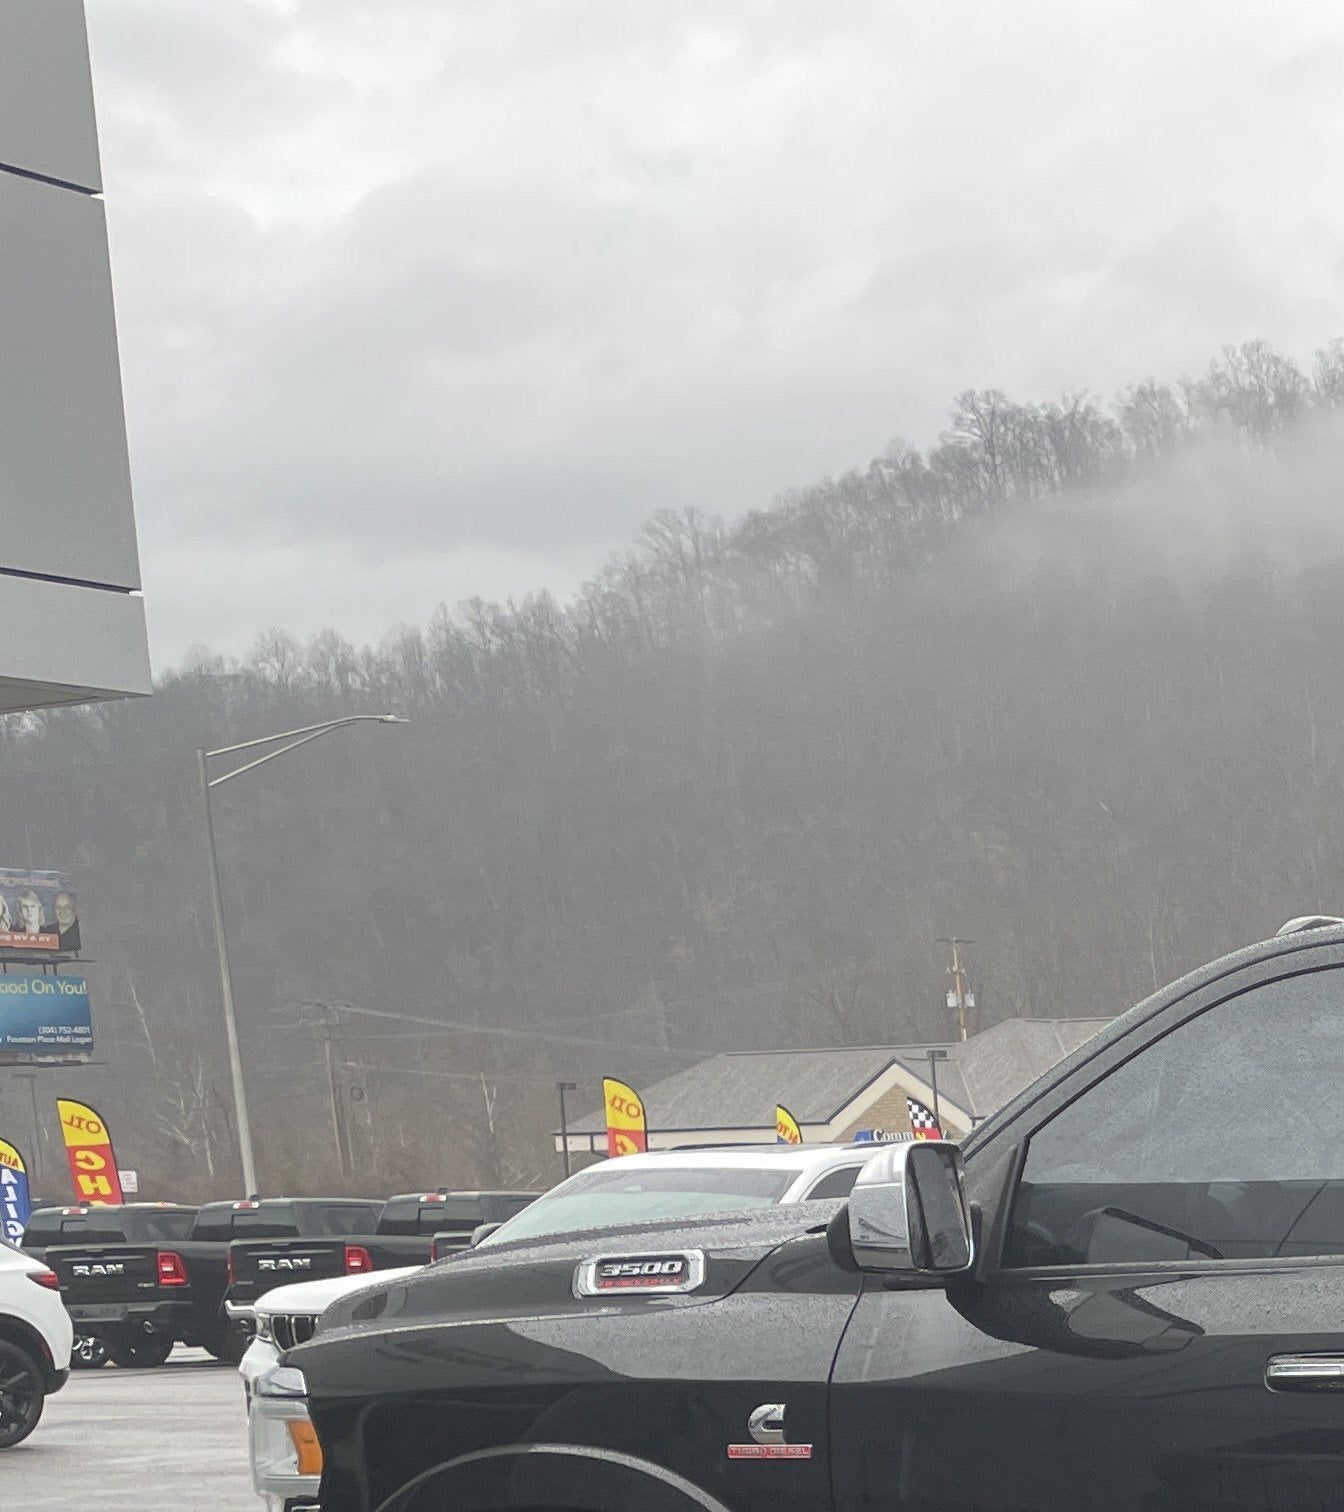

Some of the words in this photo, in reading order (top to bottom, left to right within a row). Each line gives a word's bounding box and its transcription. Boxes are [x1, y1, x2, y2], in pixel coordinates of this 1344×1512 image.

[32, 979, 54, 995] On
[56, 980, 88, 995] You!
[73, 1263, 124, 1276] RAM
[258, 1258, 311, 1271] RAM
[600, 1261, 682, 1277] 3500
